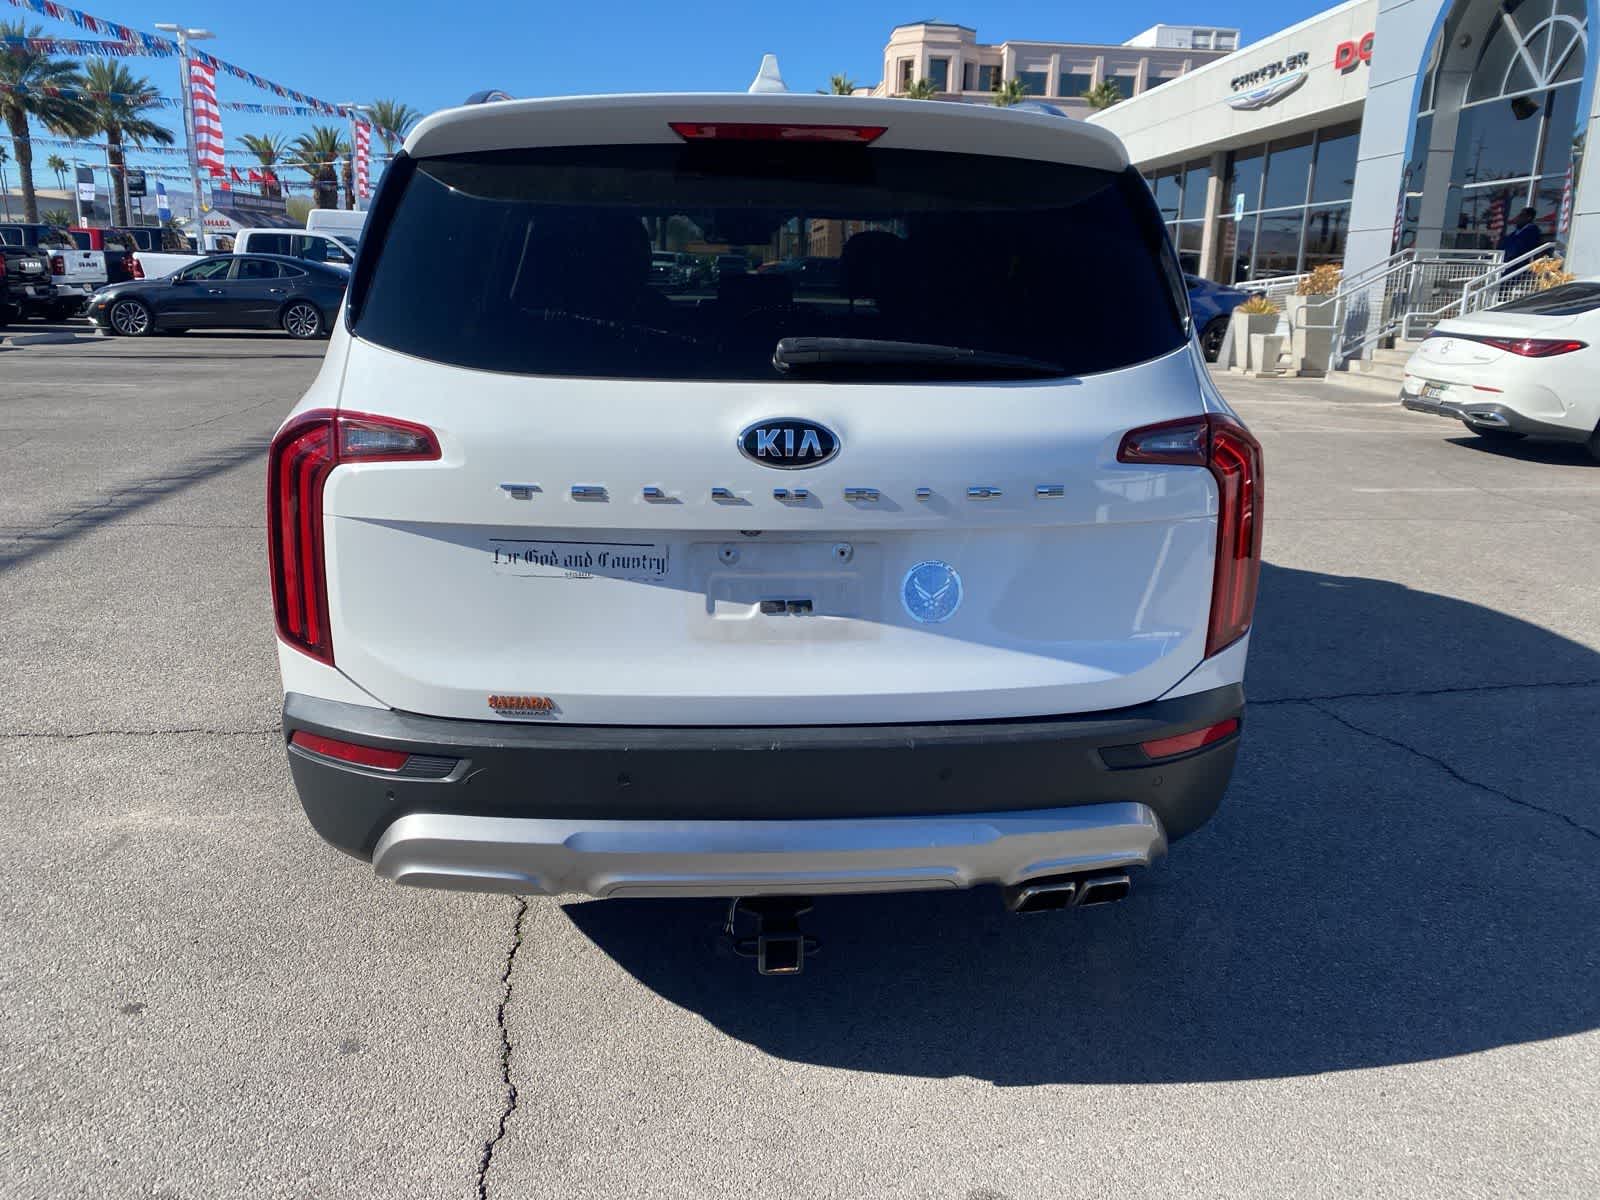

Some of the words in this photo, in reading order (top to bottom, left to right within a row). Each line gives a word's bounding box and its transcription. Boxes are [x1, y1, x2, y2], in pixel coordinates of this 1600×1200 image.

[756, 429, 823, 457] KIA
[524, 548, 560, 566] God
[563, 552, 593, 568] and
[598, 551, 667, 575] Country
[488, 695, 553, 710] SAHARA
